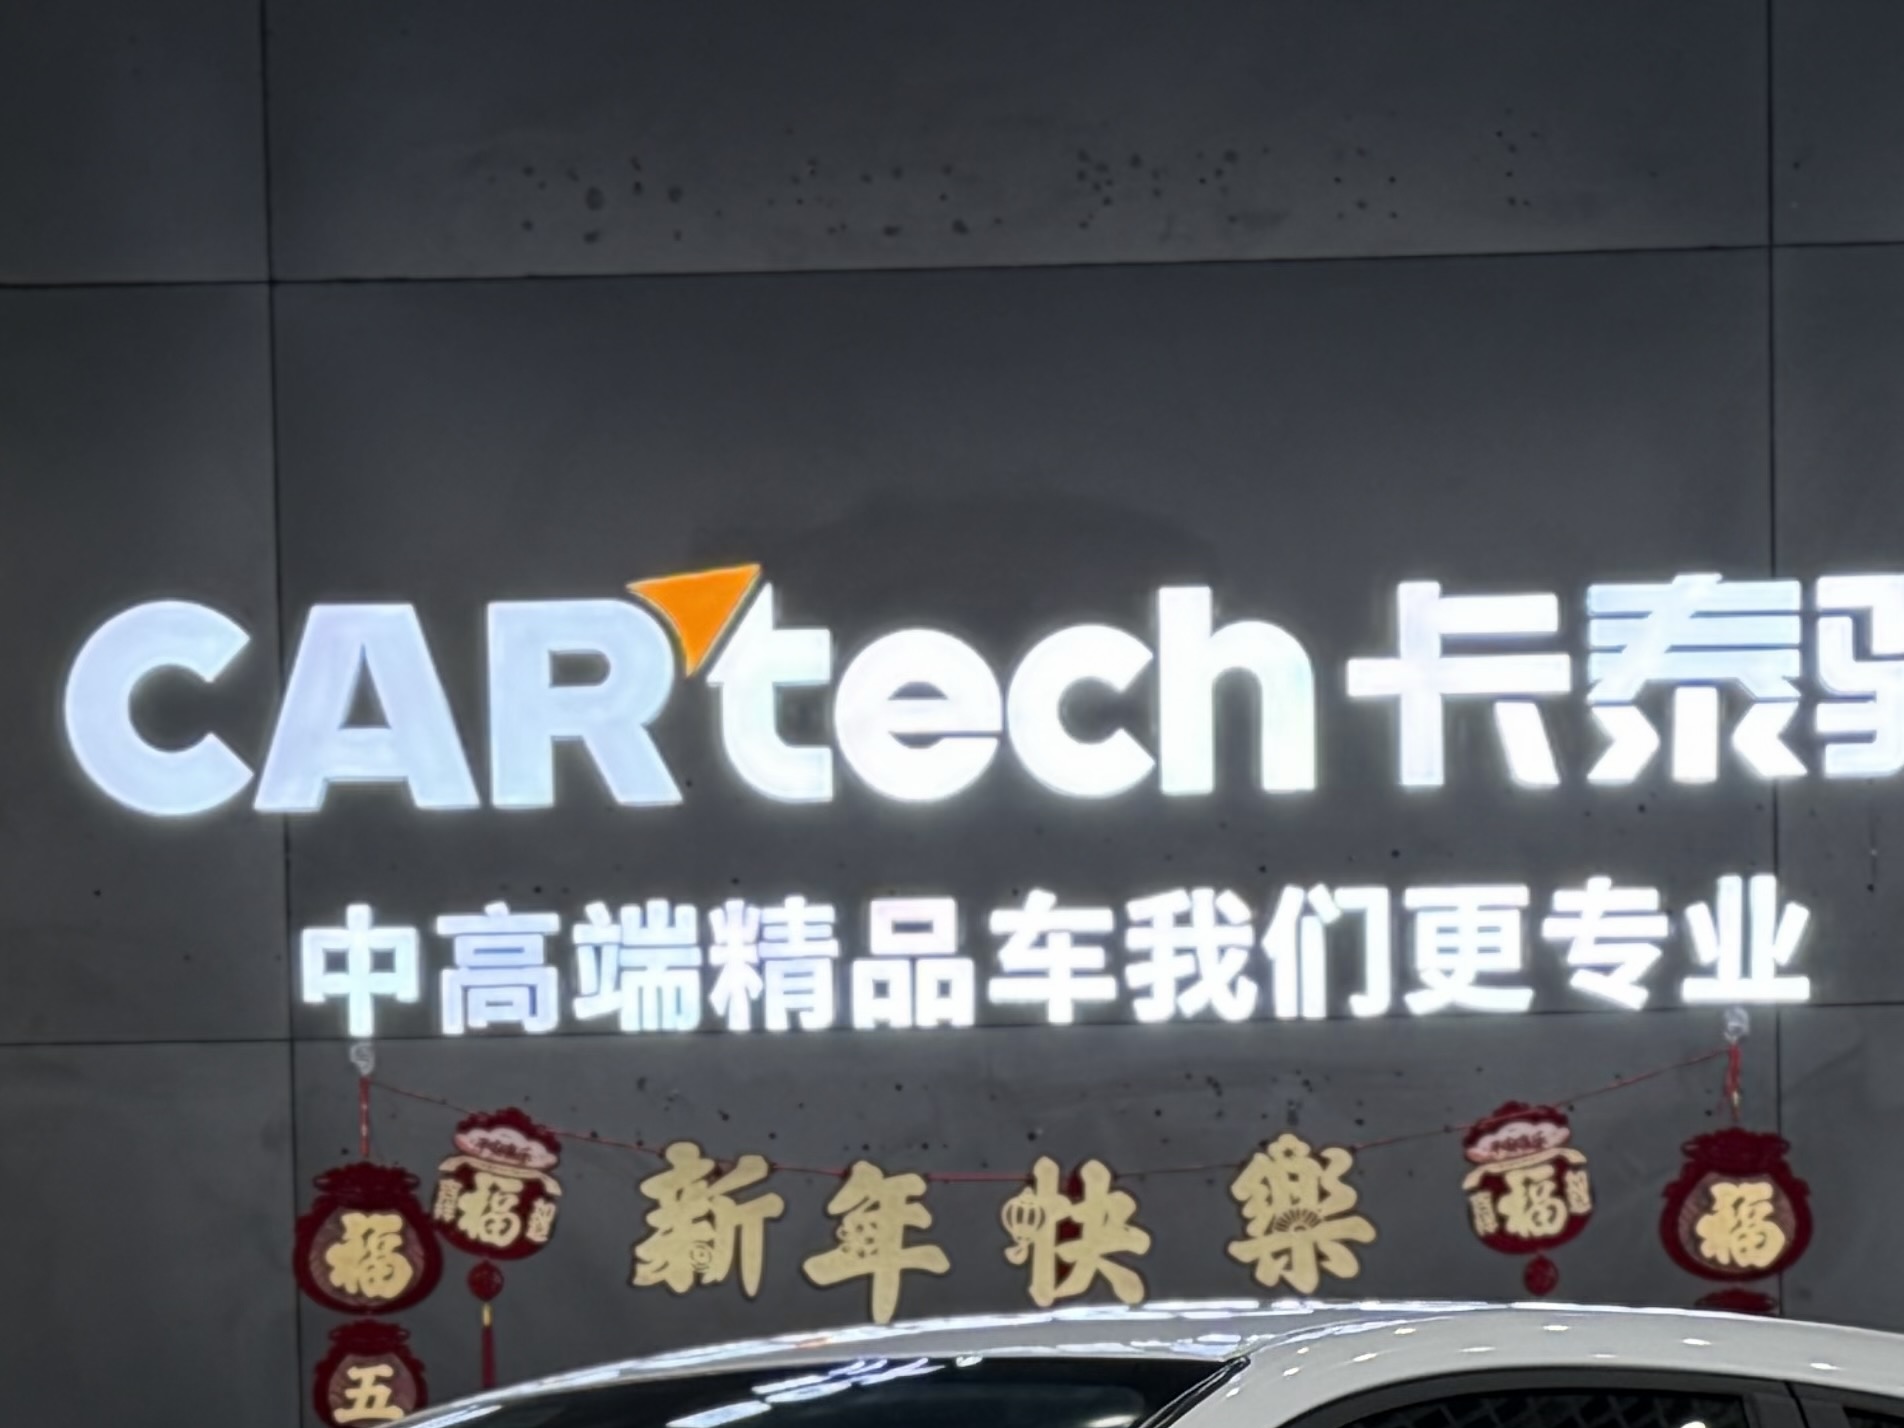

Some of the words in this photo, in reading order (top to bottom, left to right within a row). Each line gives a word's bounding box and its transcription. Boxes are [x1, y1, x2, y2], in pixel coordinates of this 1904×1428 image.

[63, 582, 1317, 816] CARtech
[300, 873, 1812, 1038] 中高端精品车我们更专业
[457, 1170, 523, 1248] 福
[1497, 1164, 1569, 1240] 福
[1695, 1181, 1786, 1267] 福
[325, 1212, 415, 1298] 福
[333, 1363, 405, 1423] 五
